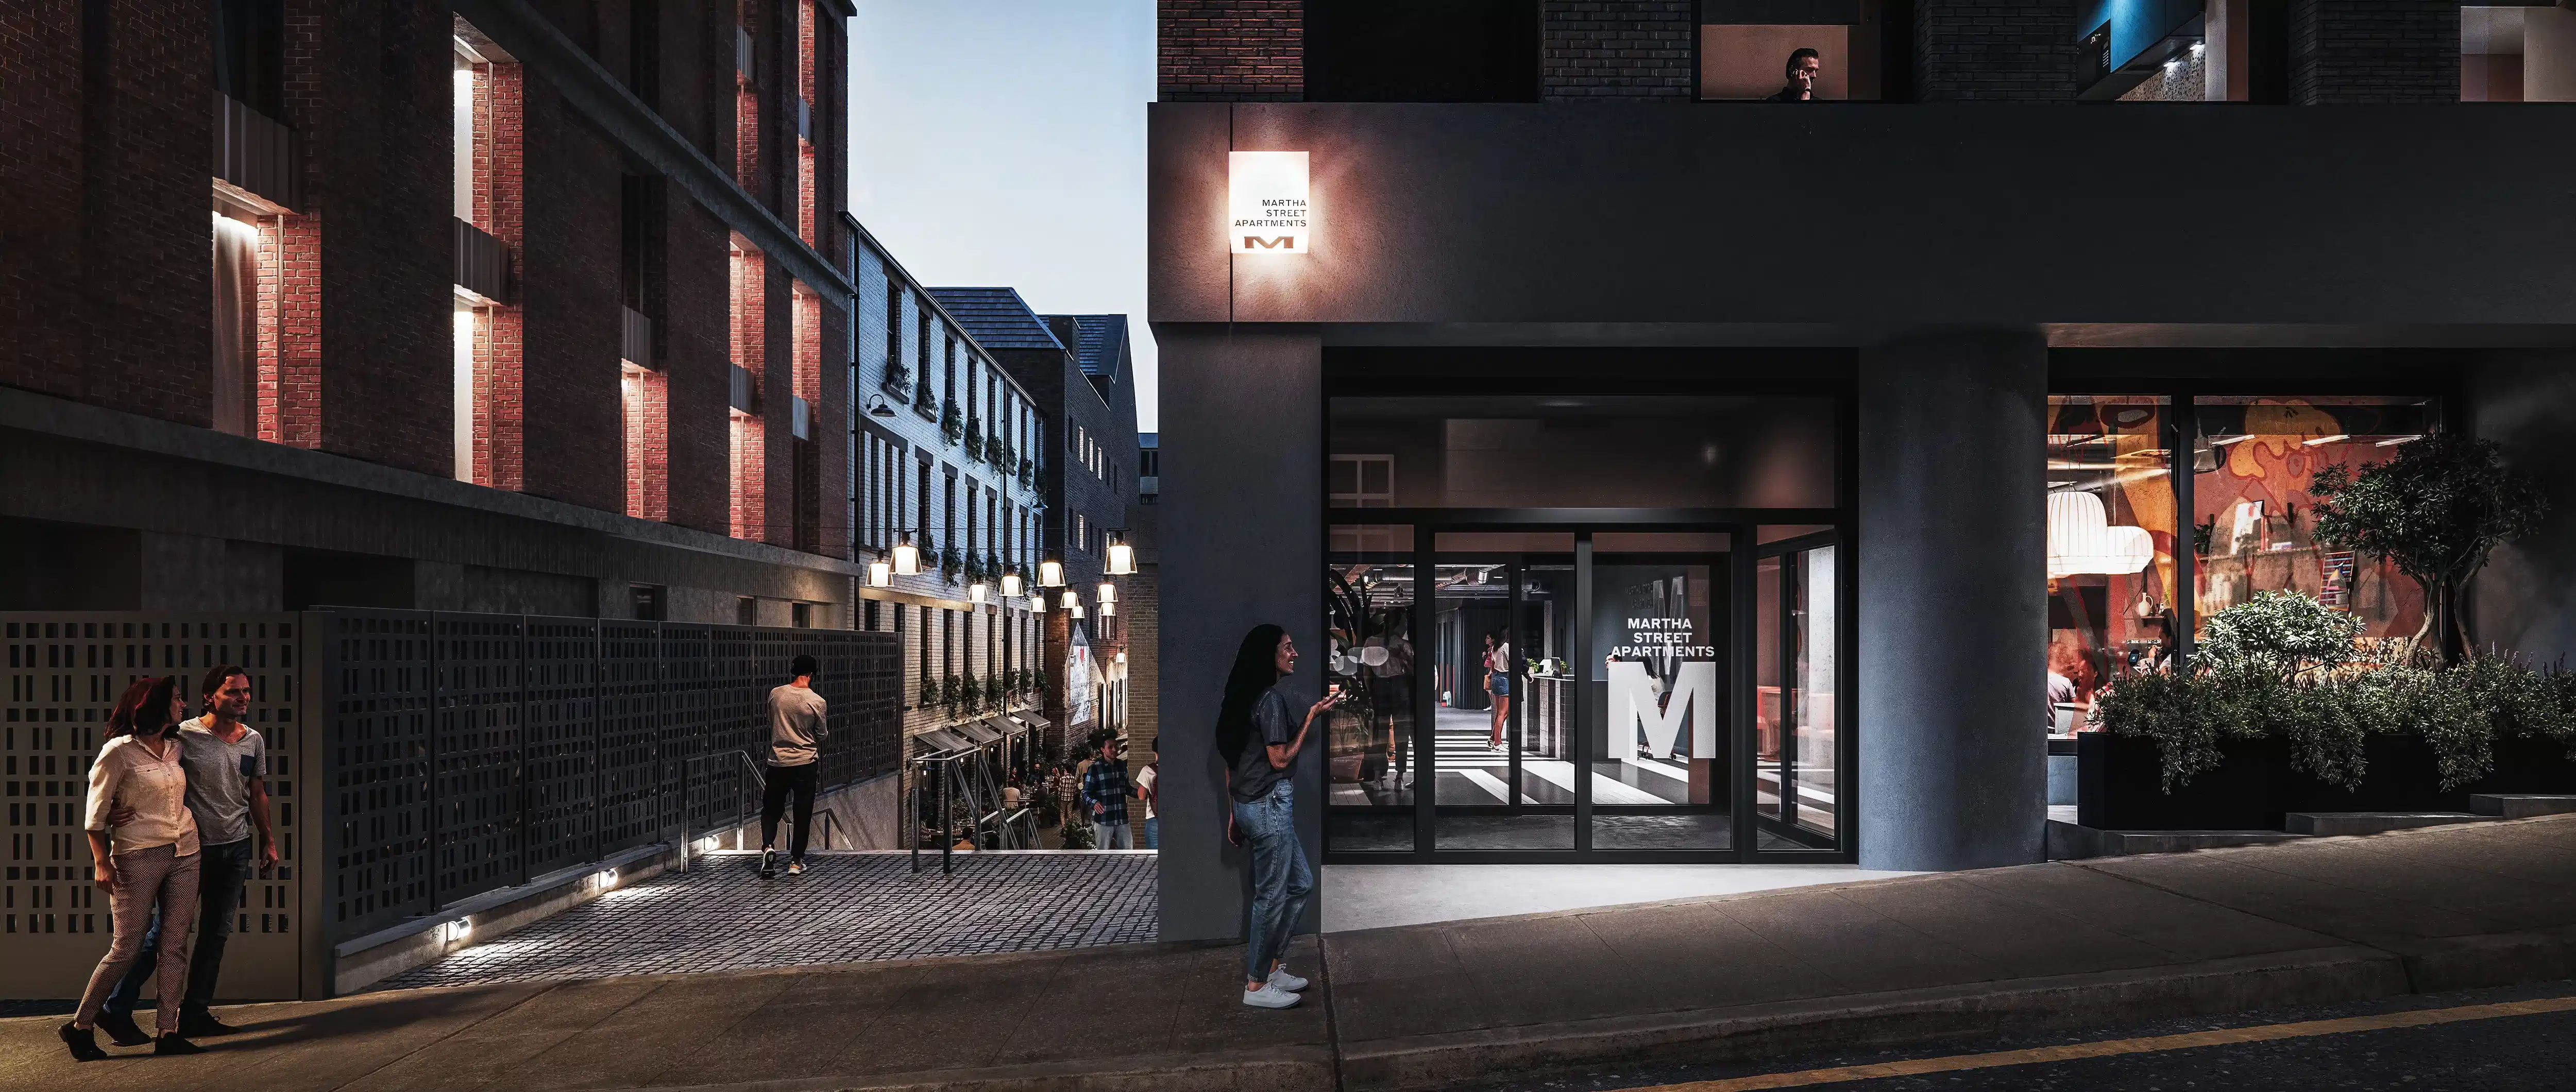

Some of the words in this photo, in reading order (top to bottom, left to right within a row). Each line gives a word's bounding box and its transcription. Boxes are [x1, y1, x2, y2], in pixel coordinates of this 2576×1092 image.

[1244, 236, 1294, 248] M
[1628, 618, 1692, 629] MARTHA
[1634, 633, 1692, 643] STREET
[1612, 646, 1715, 657] APARTMENTS
[1608, 661, 1716, 759] M
